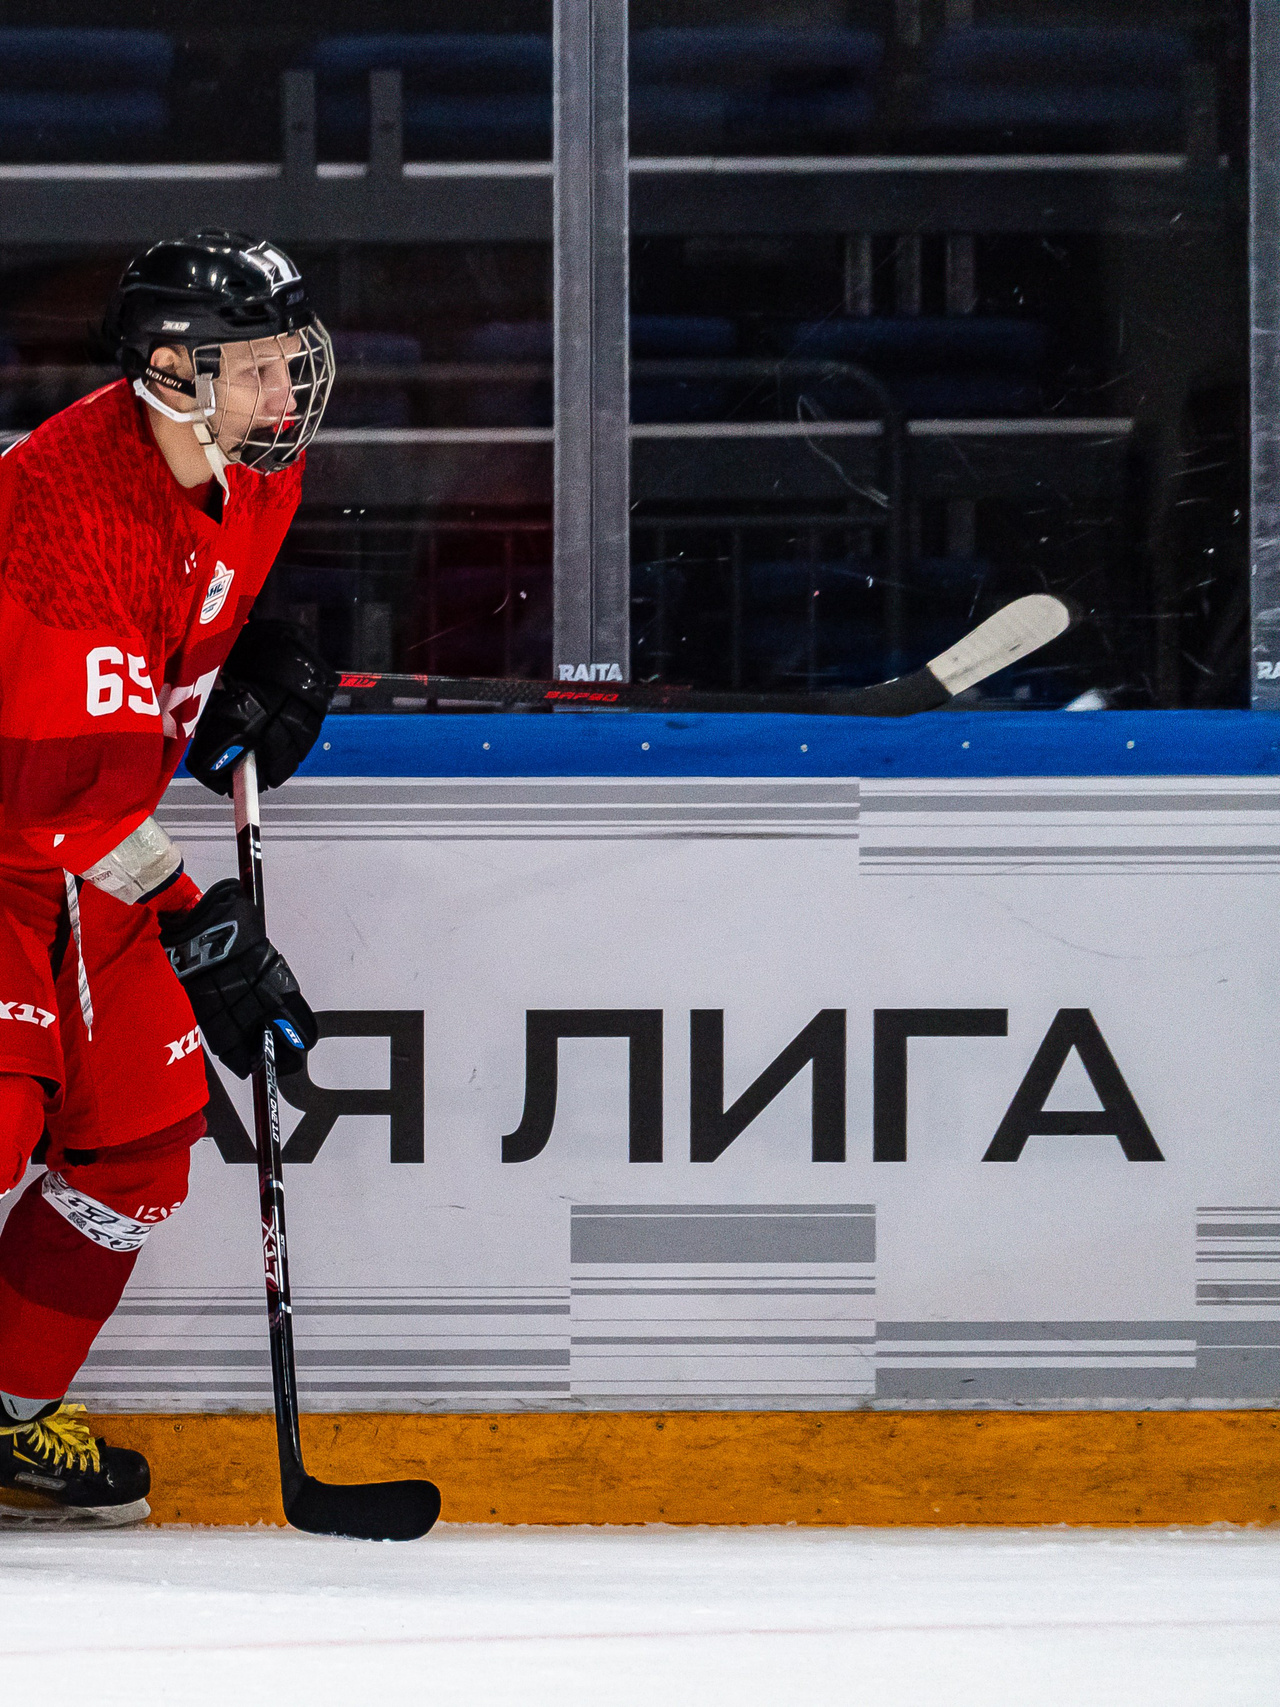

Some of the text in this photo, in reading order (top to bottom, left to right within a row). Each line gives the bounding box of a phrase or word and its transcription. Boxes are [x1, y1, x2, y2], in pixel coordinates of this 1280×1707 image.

[86, 646, 161, 717] 65
[558, 662, 623, 682] RAITA
[501, 1008, 1166, 1164] ЛИГА
[270, 1098, 278, 1125] ONE
[271, 1123, 280, 1143] 1.0
